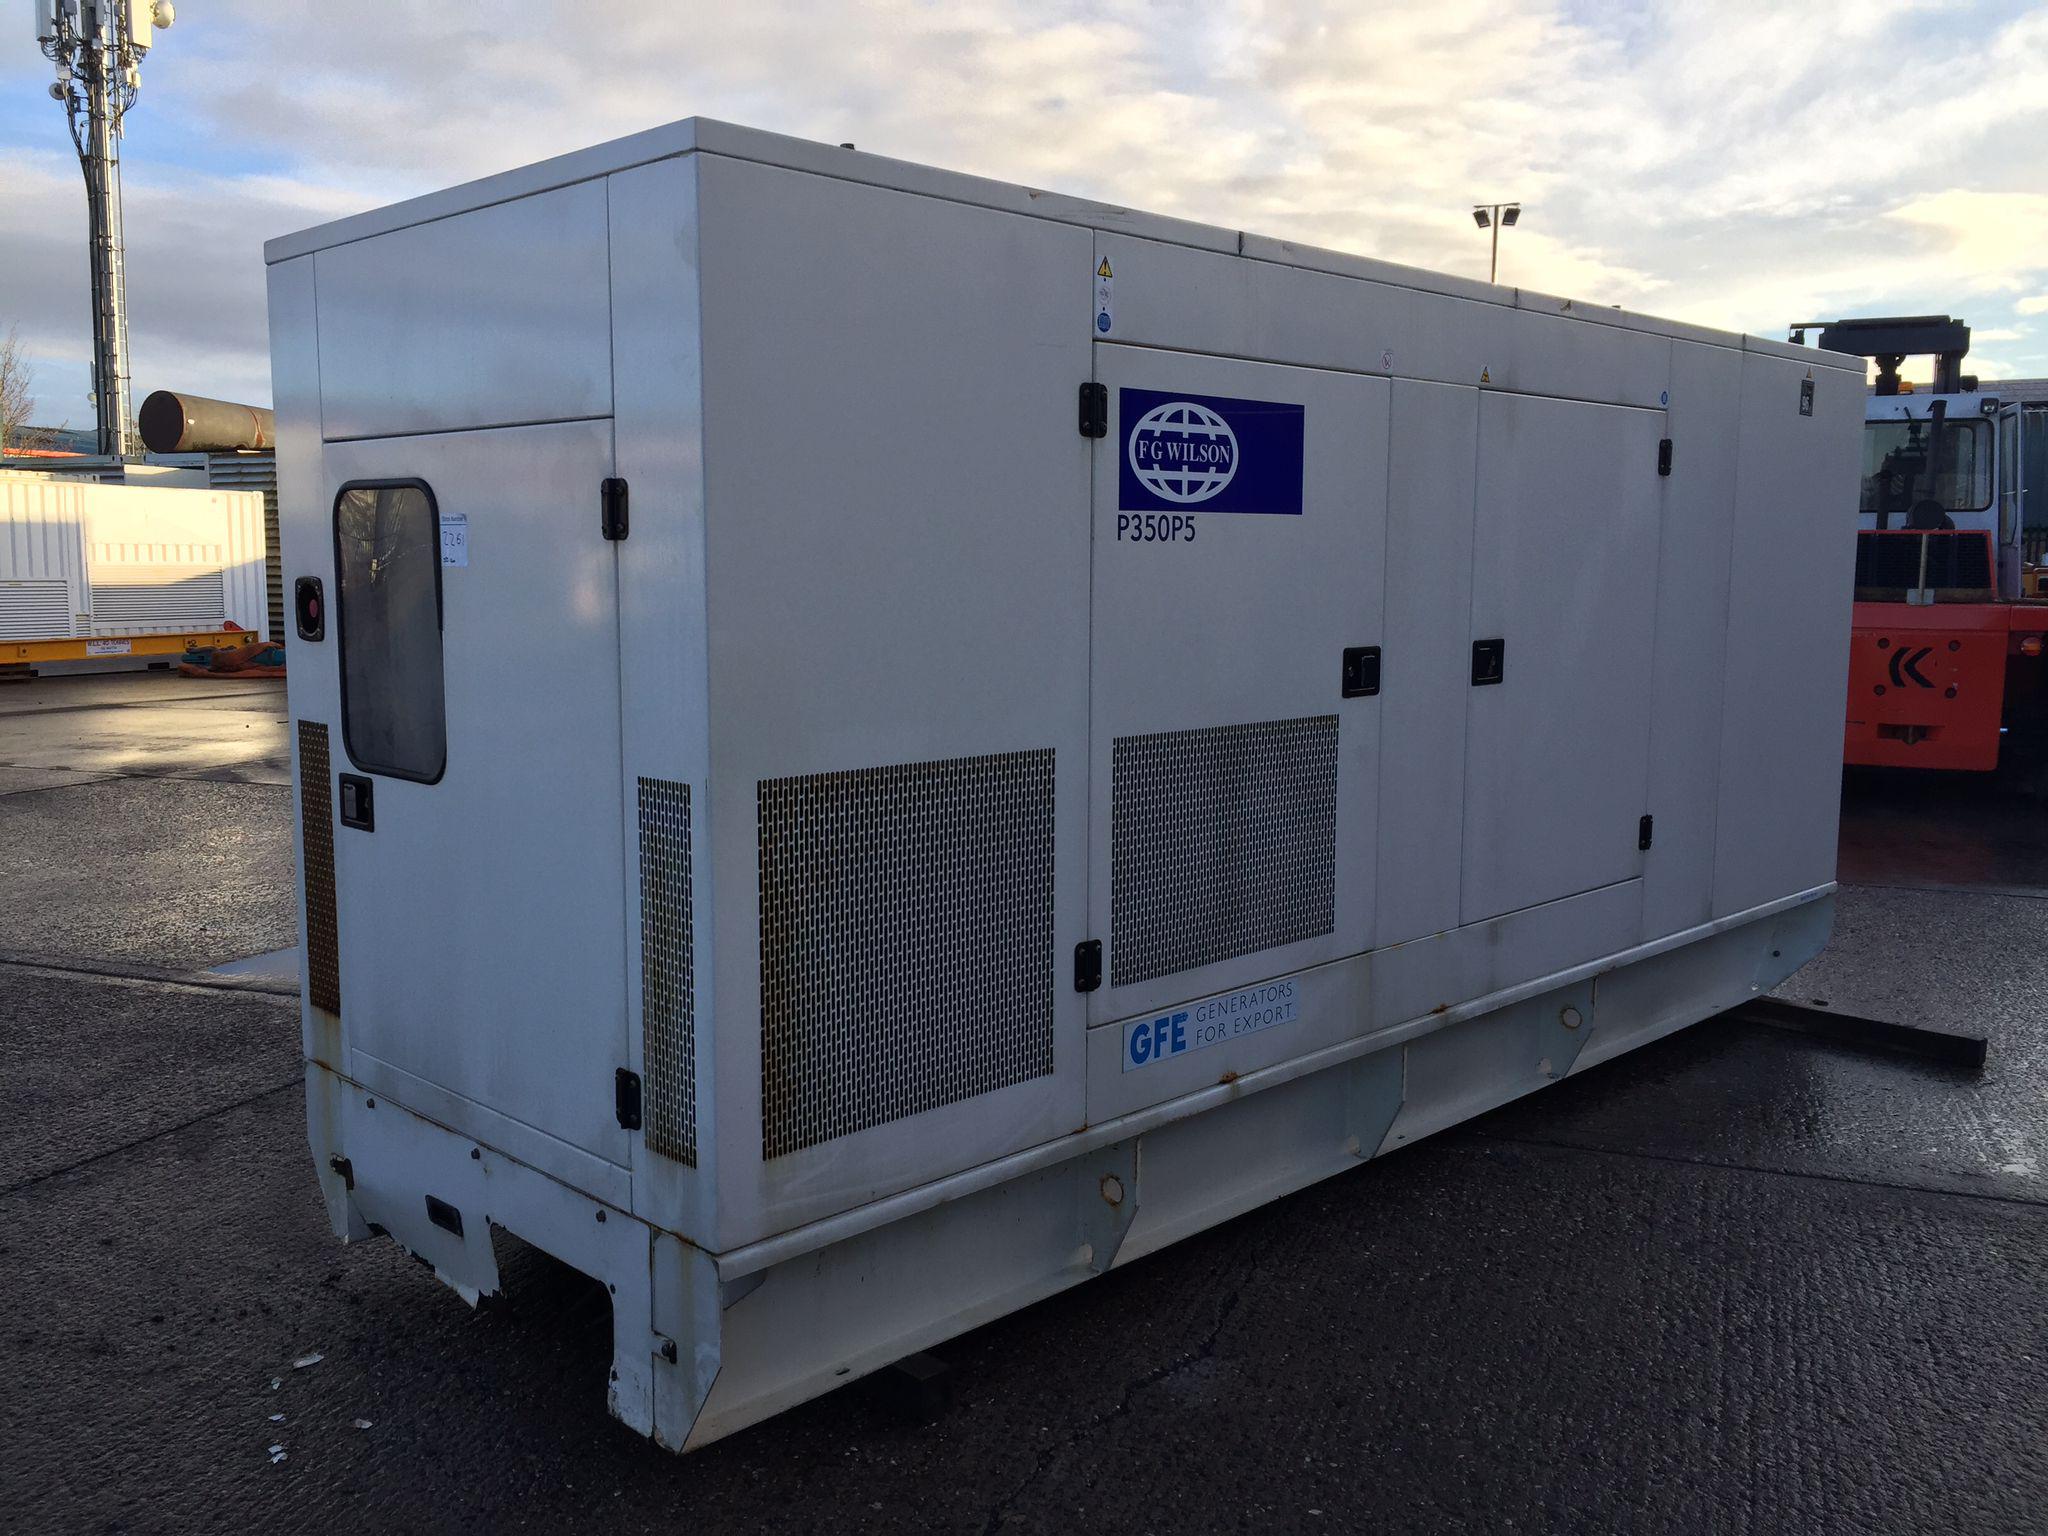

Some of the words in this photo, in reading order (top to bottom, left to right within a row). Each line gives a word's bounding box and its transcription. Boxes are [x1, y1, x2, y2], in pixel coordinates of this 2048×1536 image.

[1138, 440, 1163, 460] FG
[1166, 442, 1230, 463] WILSON
[1117, 514, 1196, 542] P350P5
[1130, 1011, 1189, 1065] GFE
[1196, 981, 1293, 1022] GENERATORS
[1196, 1022, 1227, 1046] FOR
[1234, 1002, 1292, 1034] EXPORT
